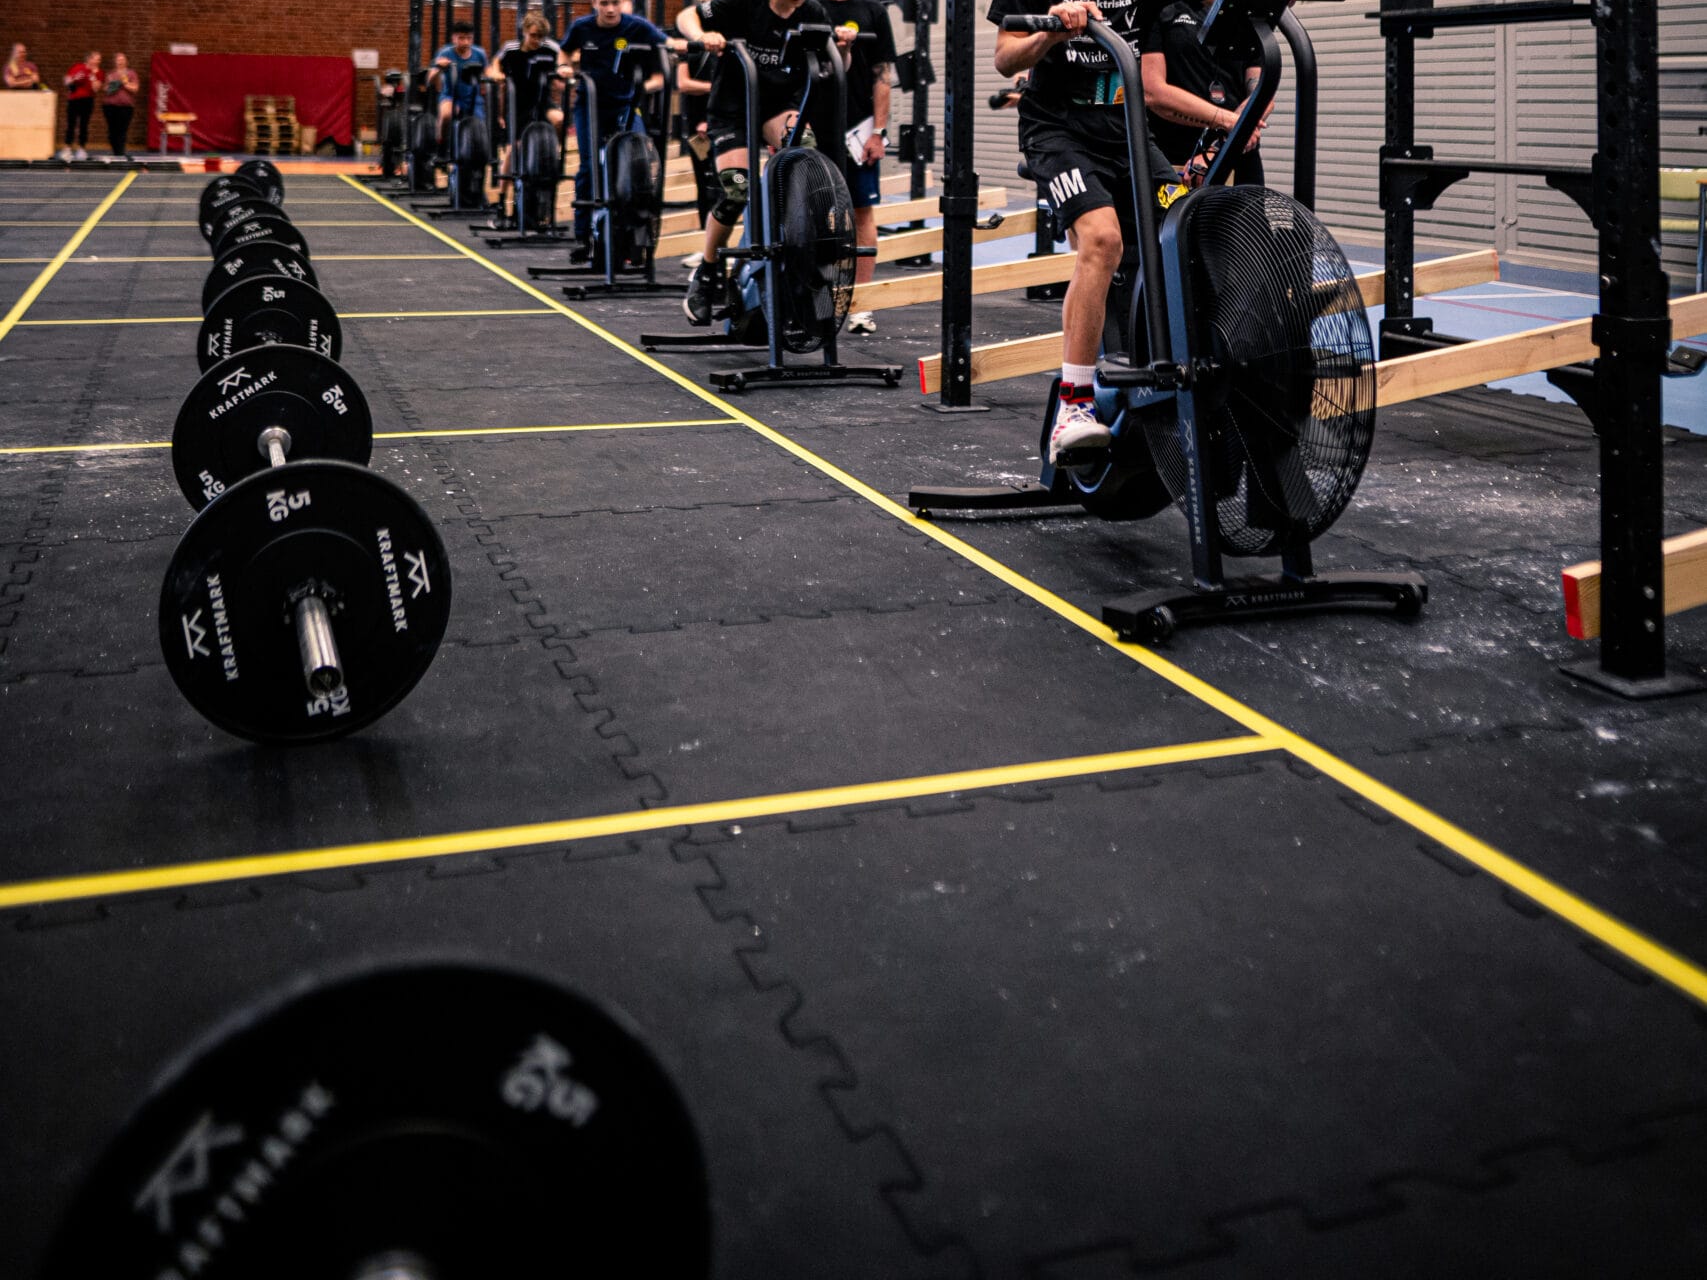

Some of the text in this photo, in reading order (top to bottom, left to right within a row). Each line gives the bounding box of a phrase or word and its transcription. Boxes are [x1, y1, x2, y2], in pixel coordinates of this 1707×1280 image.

[1078, 50, 1109, 63] Wide
[1048, 167, 1087, 208] NM
[261, 285, 274, 302] KG
[274, 289, 286, 300] 5
[208, 370, 279, 421] KRAFTMARK
[321, 384, 344, 405] KG
[331, 399, 349, 416] 5
[198, 469, 214, 487] 5
[202, 480, 226, 502] KG
[288, 489, 312, 511] 5
[266, 488, 289, 523] KG
[375, 527, 409, 634] KRAFTMARK
[206, 573, 240, 683] KRAFTMARK
[306, 698, 330, 718] 5
